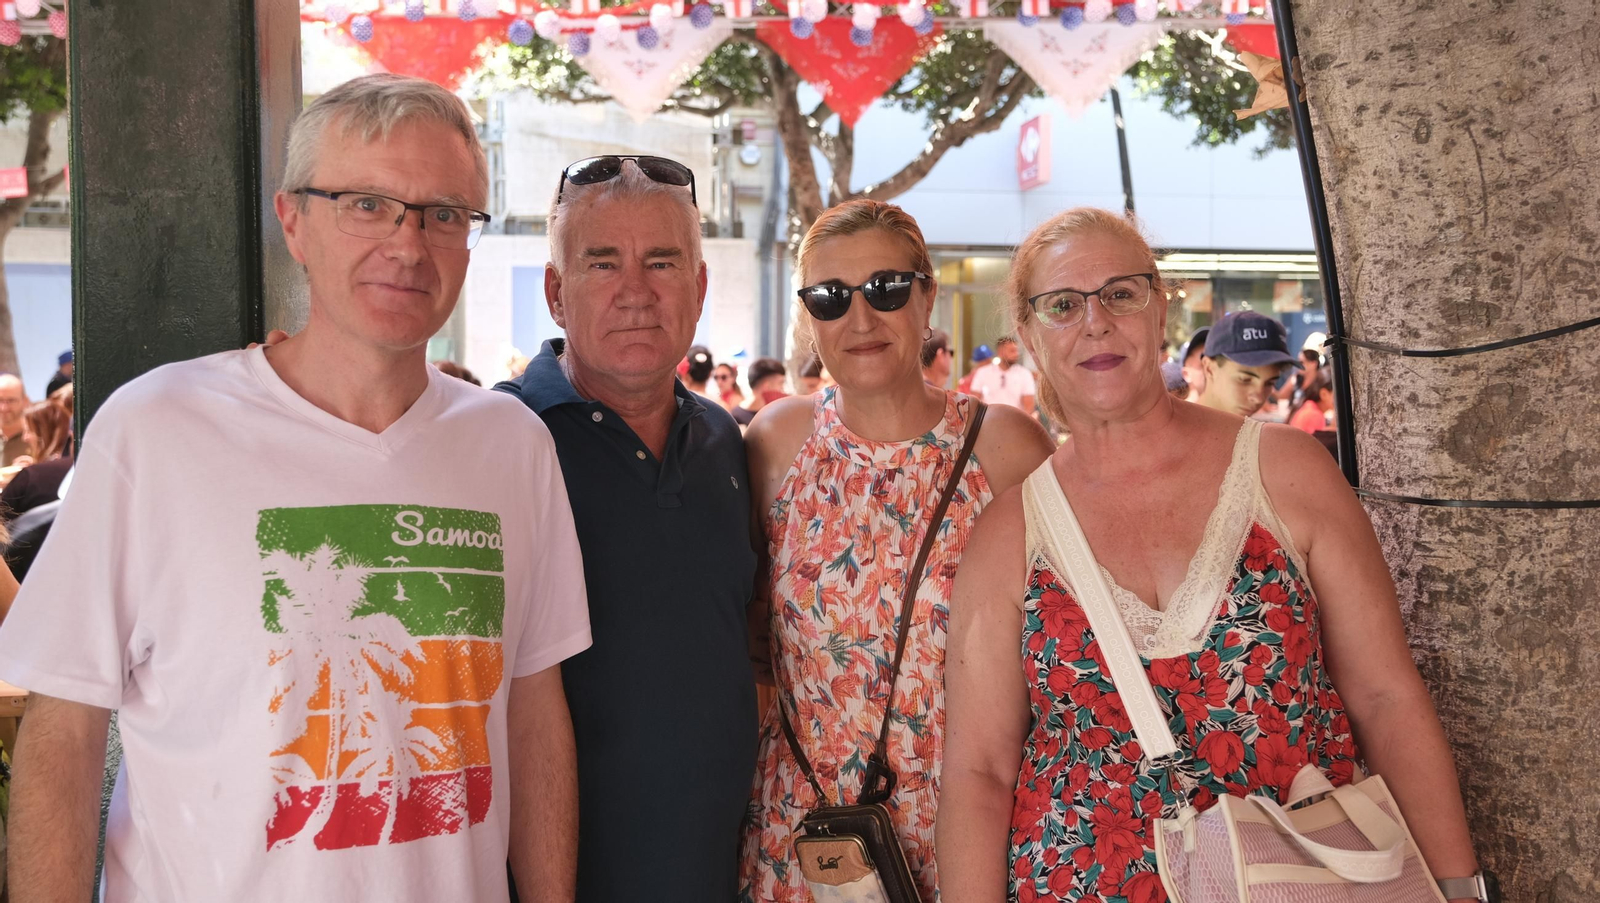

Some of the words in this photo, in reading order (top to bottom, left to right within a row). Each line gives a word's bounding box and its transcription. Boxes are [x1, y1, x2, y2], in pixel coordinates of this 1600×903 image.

[391, 510, 503, 550] Samoa
[1080, 573, 1105, 616] algodon
[1099, 615, 1114, 637] don
[1107, 637, 1135, 685] algodon
[1128, 685, 1145, 709] don
[1139, 709, 1166, 754] algodo
